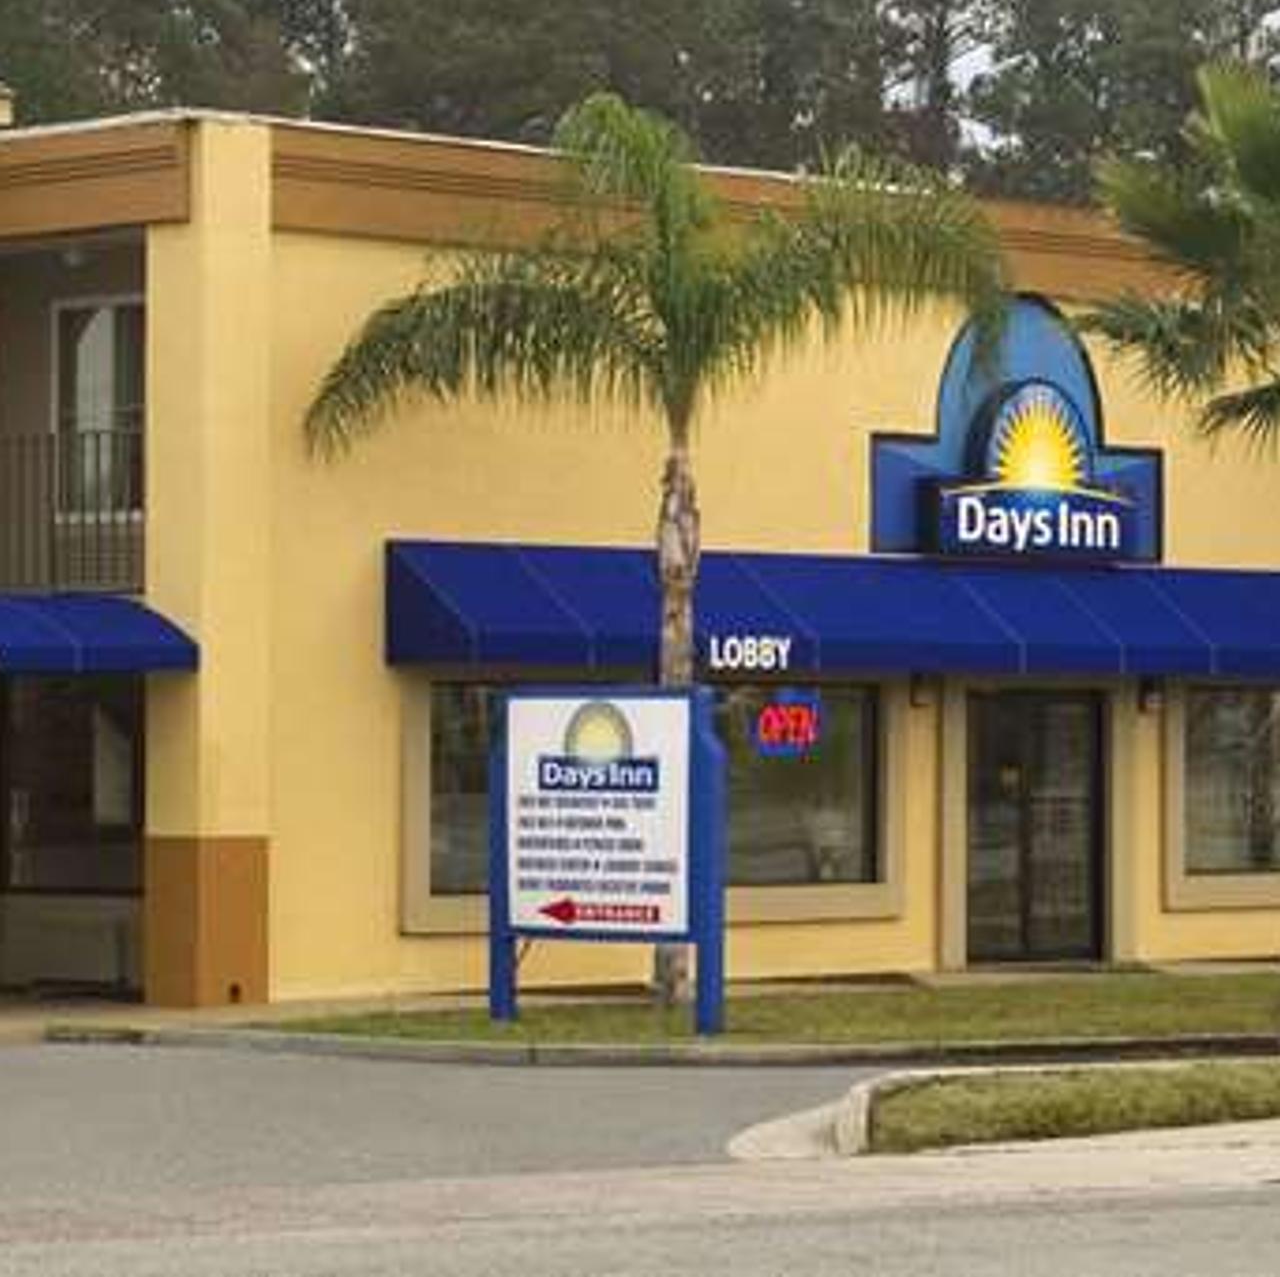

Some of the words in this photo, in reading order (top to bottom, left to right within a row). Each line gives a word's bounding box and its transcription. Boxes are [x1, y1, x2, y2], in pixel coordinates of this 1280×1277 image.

[957, 496, 1053, 552] Days
[1058, 501, 1119, 548] Inn
[710, 635, 791, 669] LOBBY
[543, 762, 606, 790] Days
[609, 763, 653, 786] Inn
